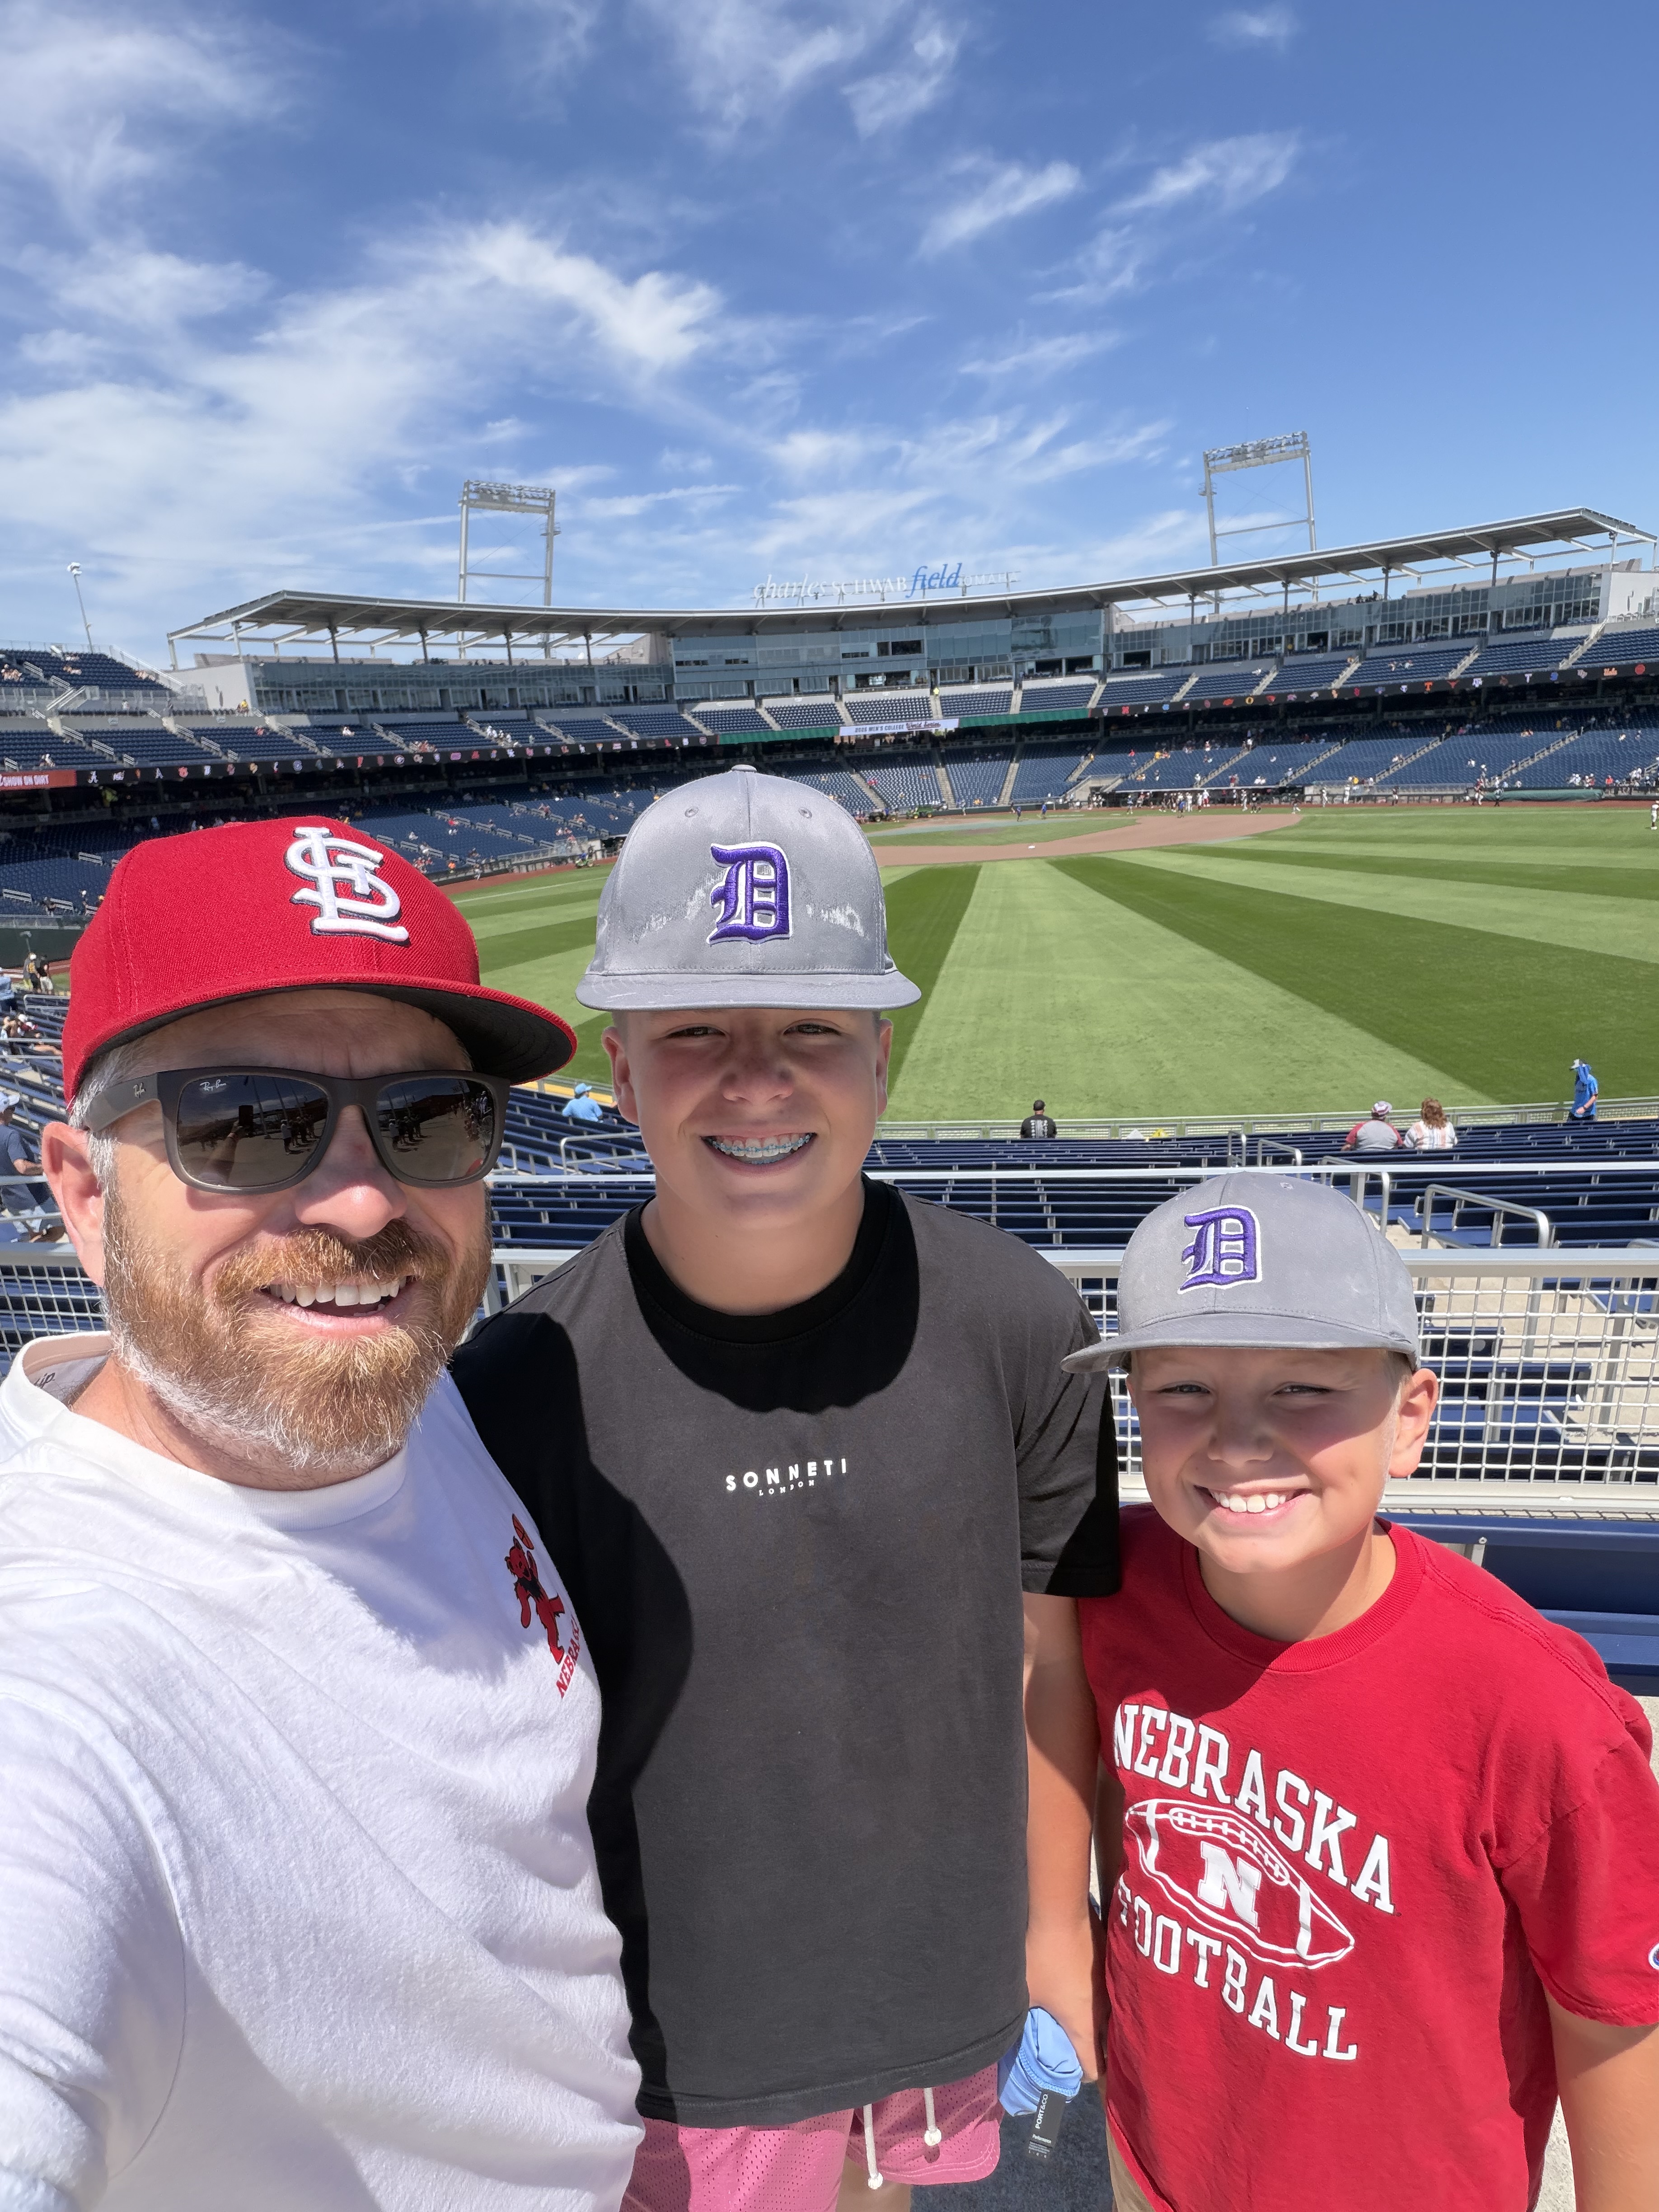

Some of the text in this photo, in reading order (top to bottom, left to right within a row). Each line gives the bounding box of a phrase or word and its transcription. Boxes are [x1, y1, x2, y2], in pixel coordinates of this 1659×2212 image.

[753, 573, 827, 599] charles
[832, 577, 907, 595] SCHWAB
[905, 563, 962, 598] field
[707, 842, 792, 944] D
[1177, 1204, 1262, 1294] D
[726, 1458, 846, 1491] SONNETI
[759, 1480, 814, 1496] LONDON
[1114, 1704, 1396, 1915] NEBRASKA
[1198, 1840, 1261, 1930] N
[1118, 1871, 1357, 2061] FOOTBALL
